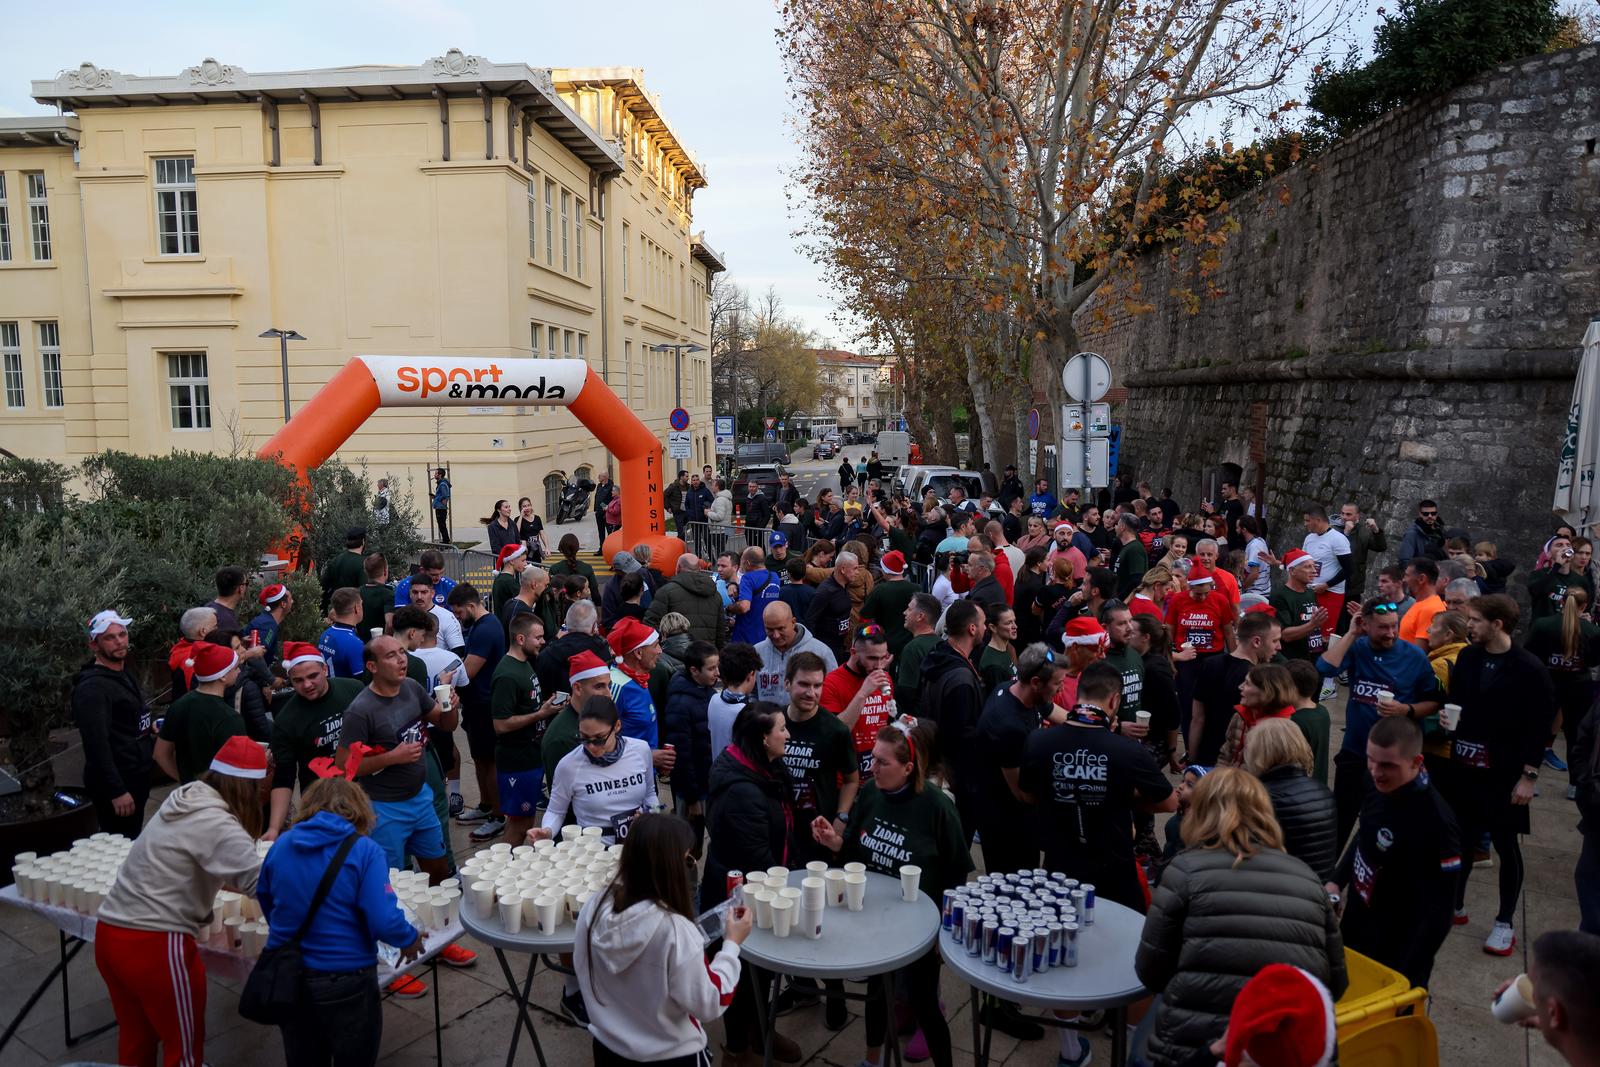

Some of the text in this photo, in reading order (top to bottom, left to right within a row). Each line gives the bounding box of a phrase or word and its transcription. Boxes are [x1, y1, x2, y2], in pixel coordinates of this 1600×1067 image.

[396, 364, 503, 399] sport
[448, 376, 566, 399] &moda
[647, 456, 659, 532] FINISH
[1188, 635, 1208, 645] 293
[866, 715, 880, 725] RUN
[784, 744, 813, 757] ZADAR
[1052, 748, 1109, 766] coffee
[585, 773, 644, 795] RUNESCO
[872, 824, 906, 847] ZADAR
[860, 831, 914, 863] CHRISTMAS
[871, 851, 894, 869] RUN
